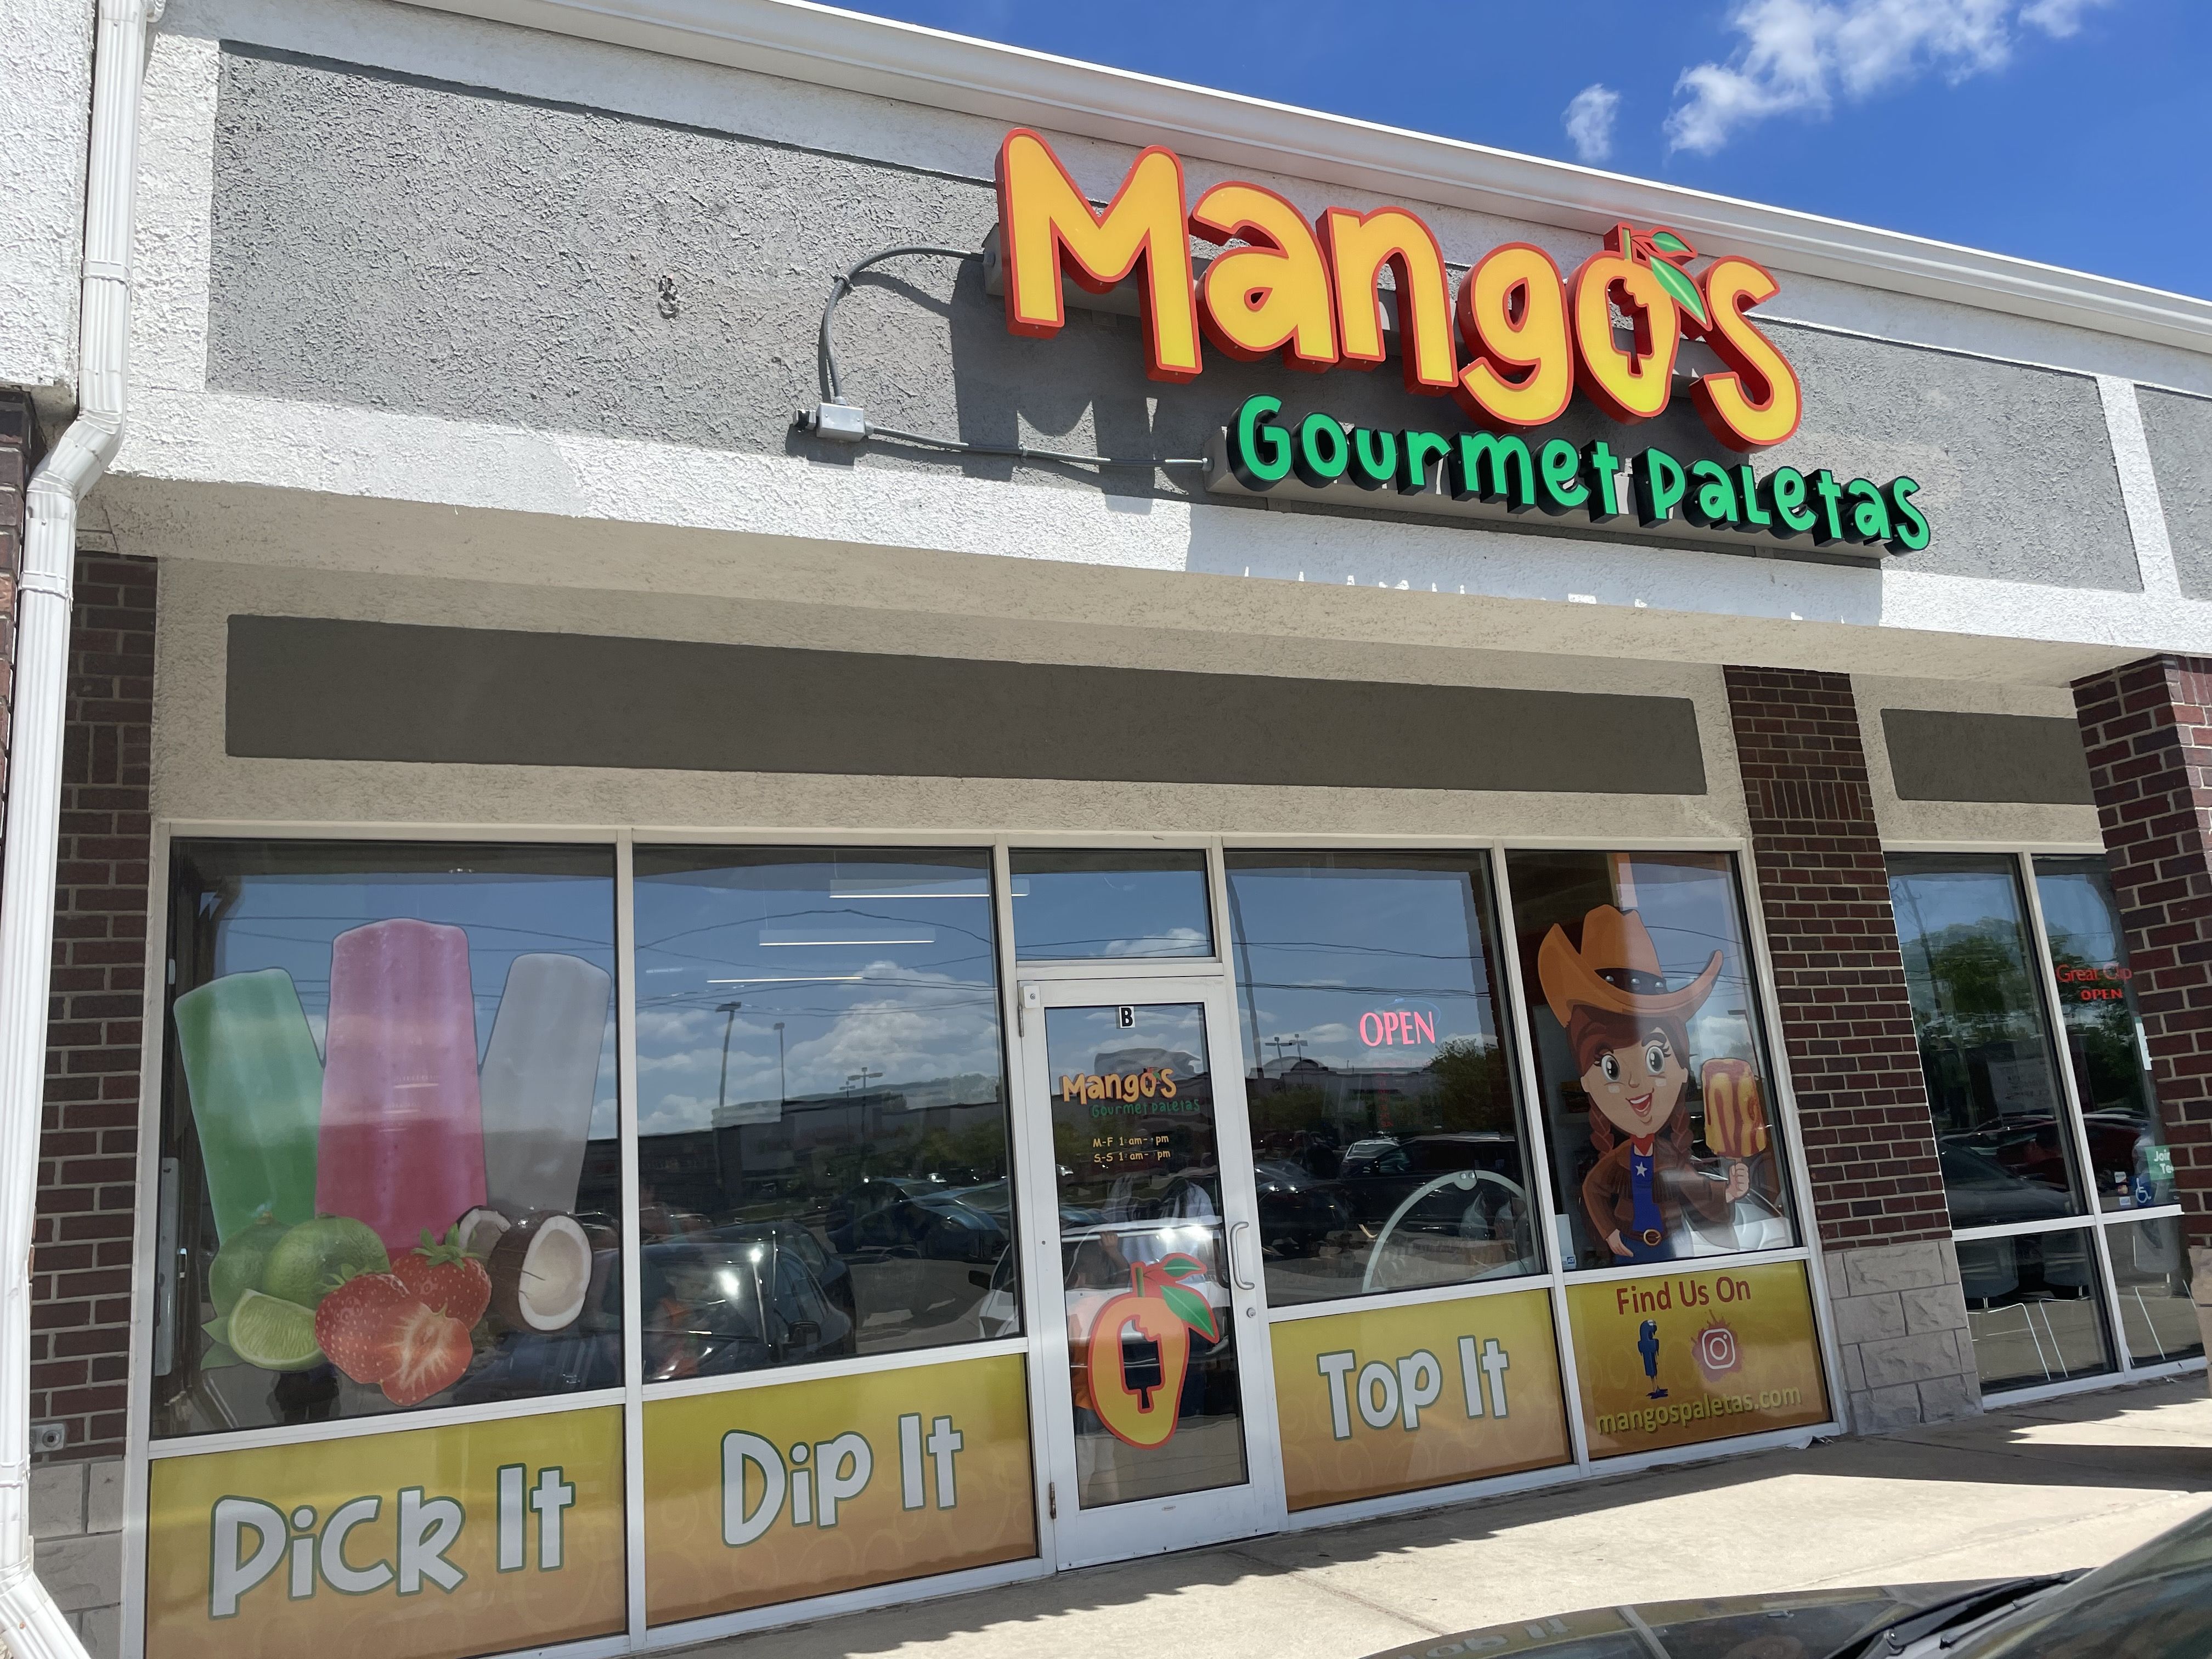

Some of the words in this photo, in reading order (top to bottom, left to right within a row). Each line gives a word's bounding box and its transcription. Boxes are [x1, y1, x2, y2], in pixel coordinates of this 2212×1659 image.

[1233, 393, 1620, 519] Gourmet
[2056, 964, 2100, 982] Great
[2080, 989, 2123, 1001] OPEN
[1121, 1007, 1133, 1027] B
[1359, 1011, 1436, 1047] OPEN
[1092, 1103, 1147, 1118] Gourmet
[1093, 1137, 1113, 1148] M-F
[1156, 1136, 1170, 1146] pm
[1094, 1153, 1113, 1163] S-S
[1157, 1150, 1171, 1161] pm
[1616, 1281, 1672, 1316] Find
[1679, 1280, 1709, 1307] Us
[1716, 1276, 1752, 1304] On
[1317, 1349, 1441, 1441] Top
[1458, 1335, 1509, 1419] It
[1595, 1385, 1802, 1434] mangospaletas.com
[721, 1430, 873, 1548] Dip
[898, 1413, 963, 1511] It
[209, 1486, 468, 1620] Pick
[497, 1463, 575, 1573] It
